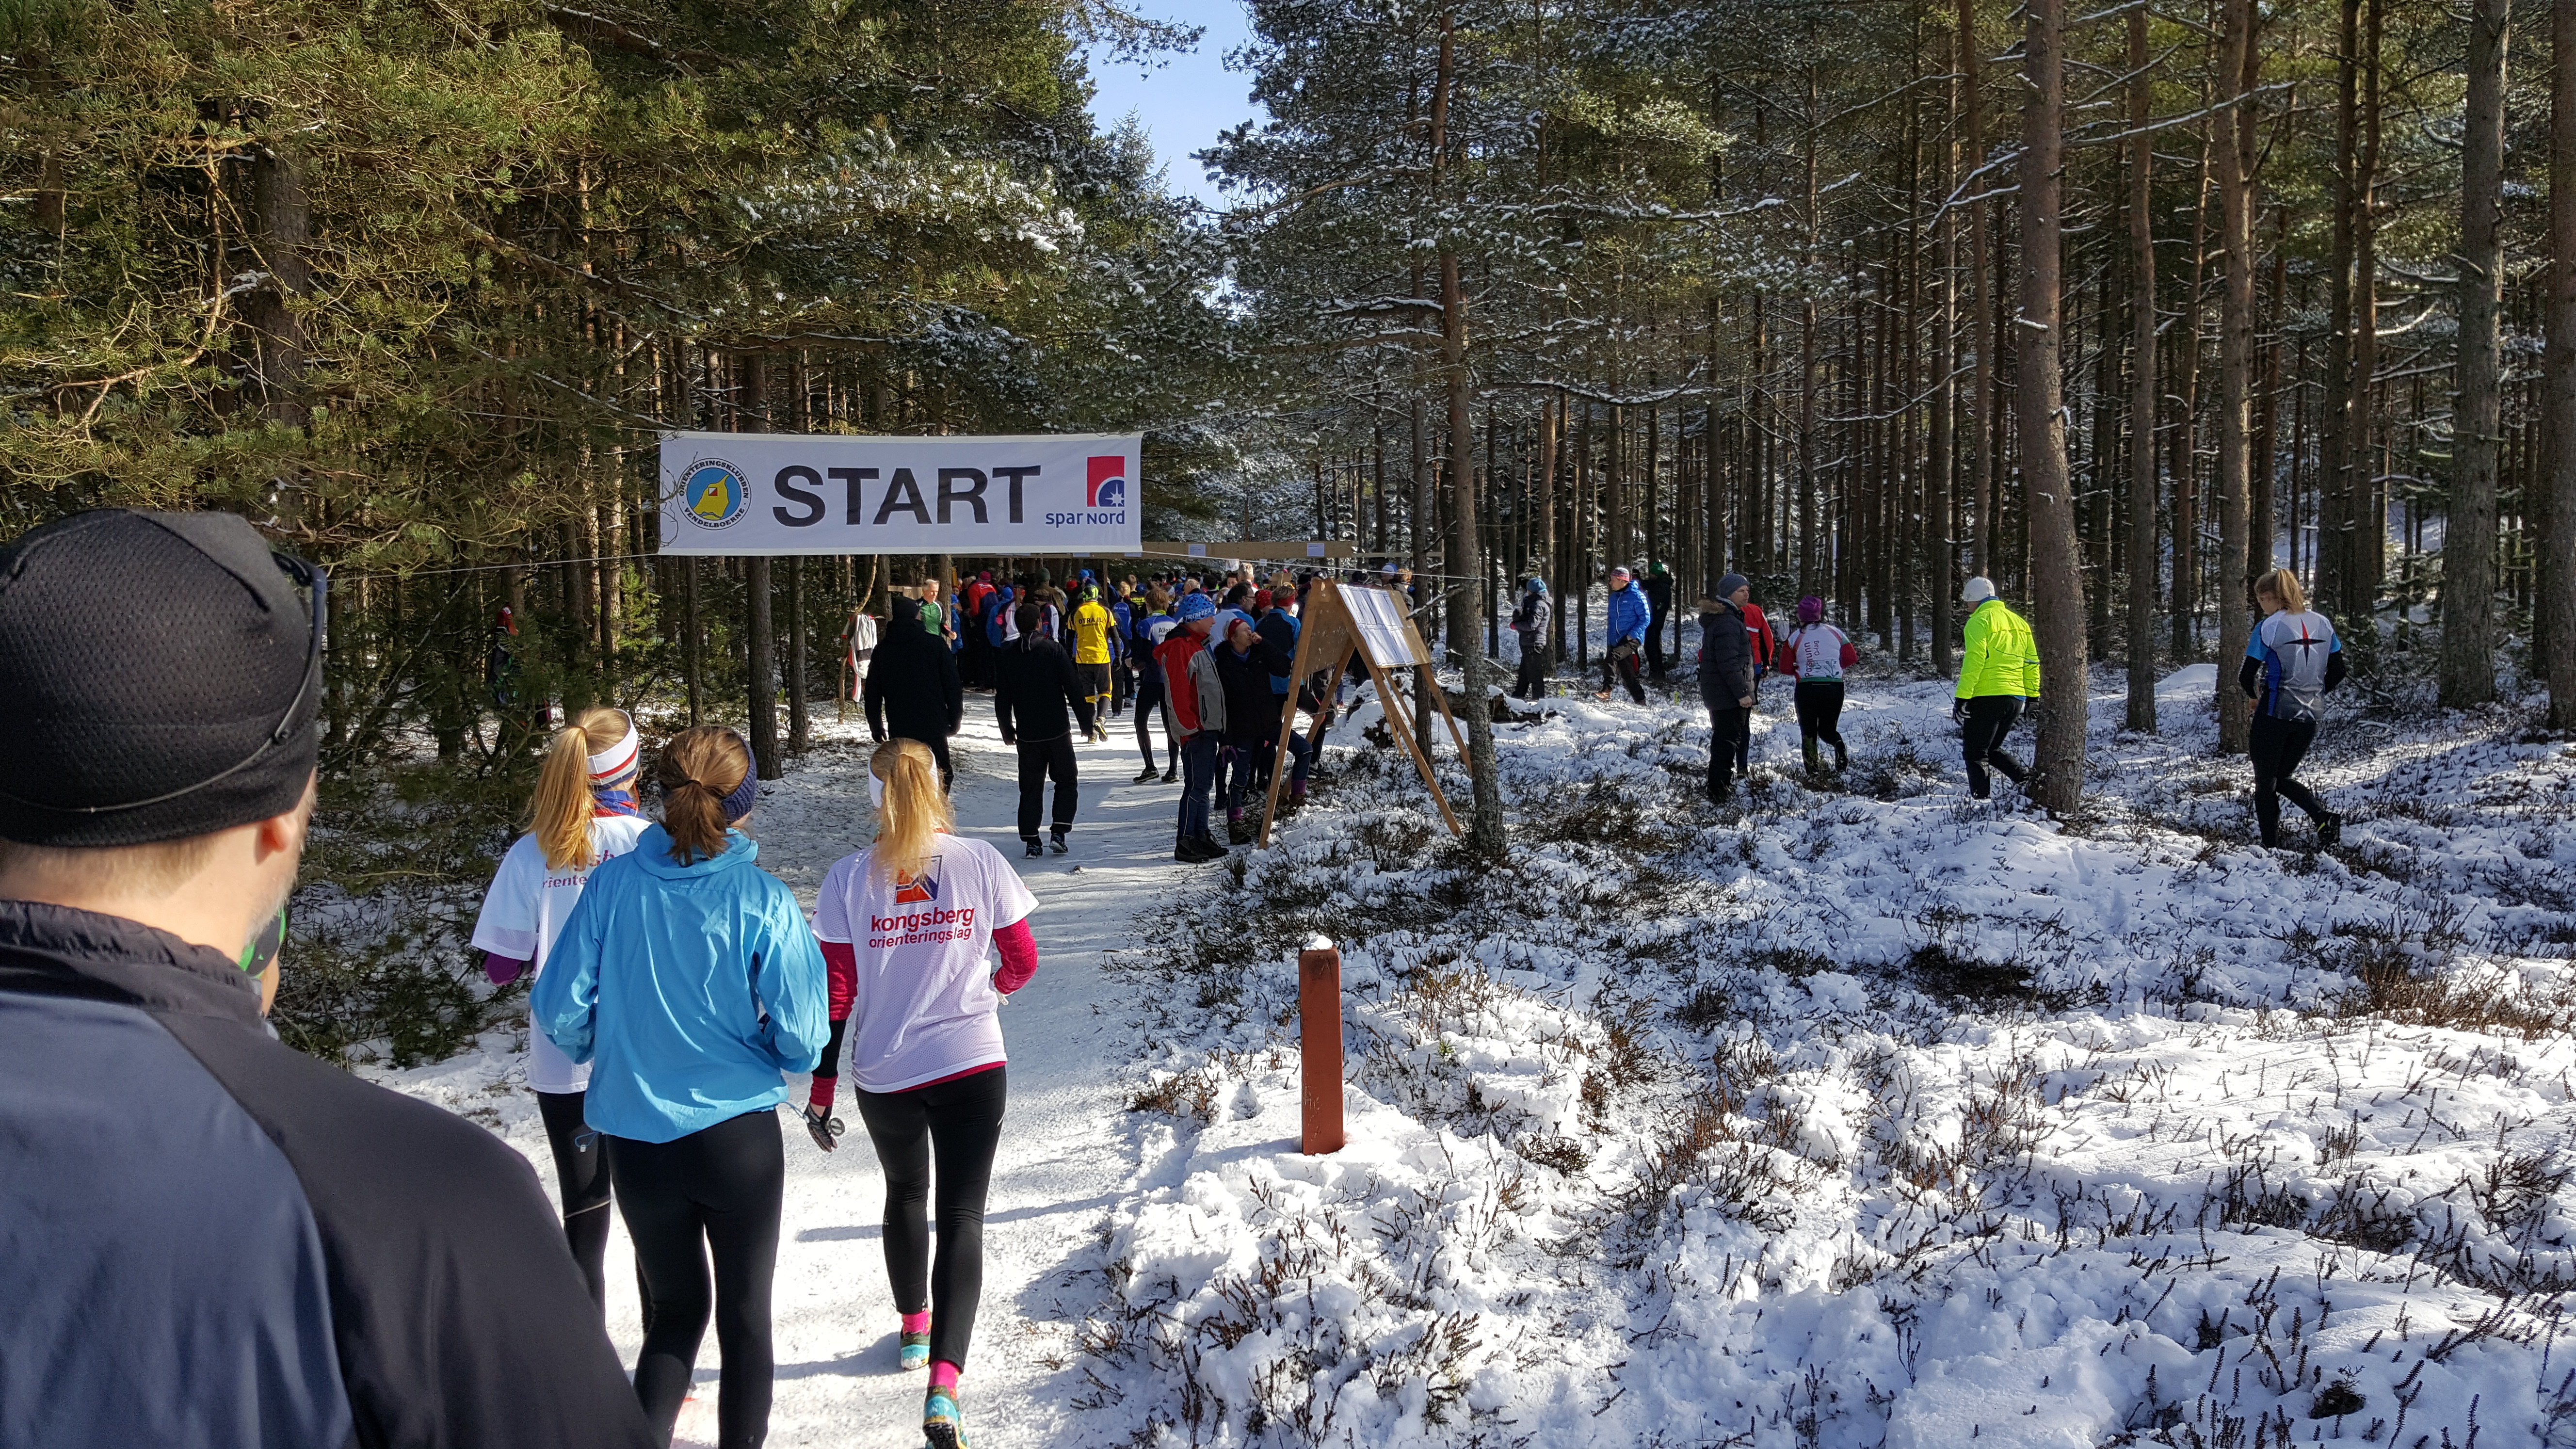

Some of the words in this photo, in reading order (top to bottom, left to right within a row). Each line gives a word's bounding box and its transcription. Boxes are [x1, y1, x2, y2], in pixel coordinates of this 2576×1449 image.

[679, 460, 749, 499] ORIENTERINGSKLUBBEN
[772, 464, 1041, 527] START
[684, 507, 745, 528] VENDELBOERNE
[1045, 513, 1084, 529] spar
[1087, 510, 1125, 525] Nord
[871, 906, 975, 933] kongsberg
[869, 927, 972, 949] orienteringslag
